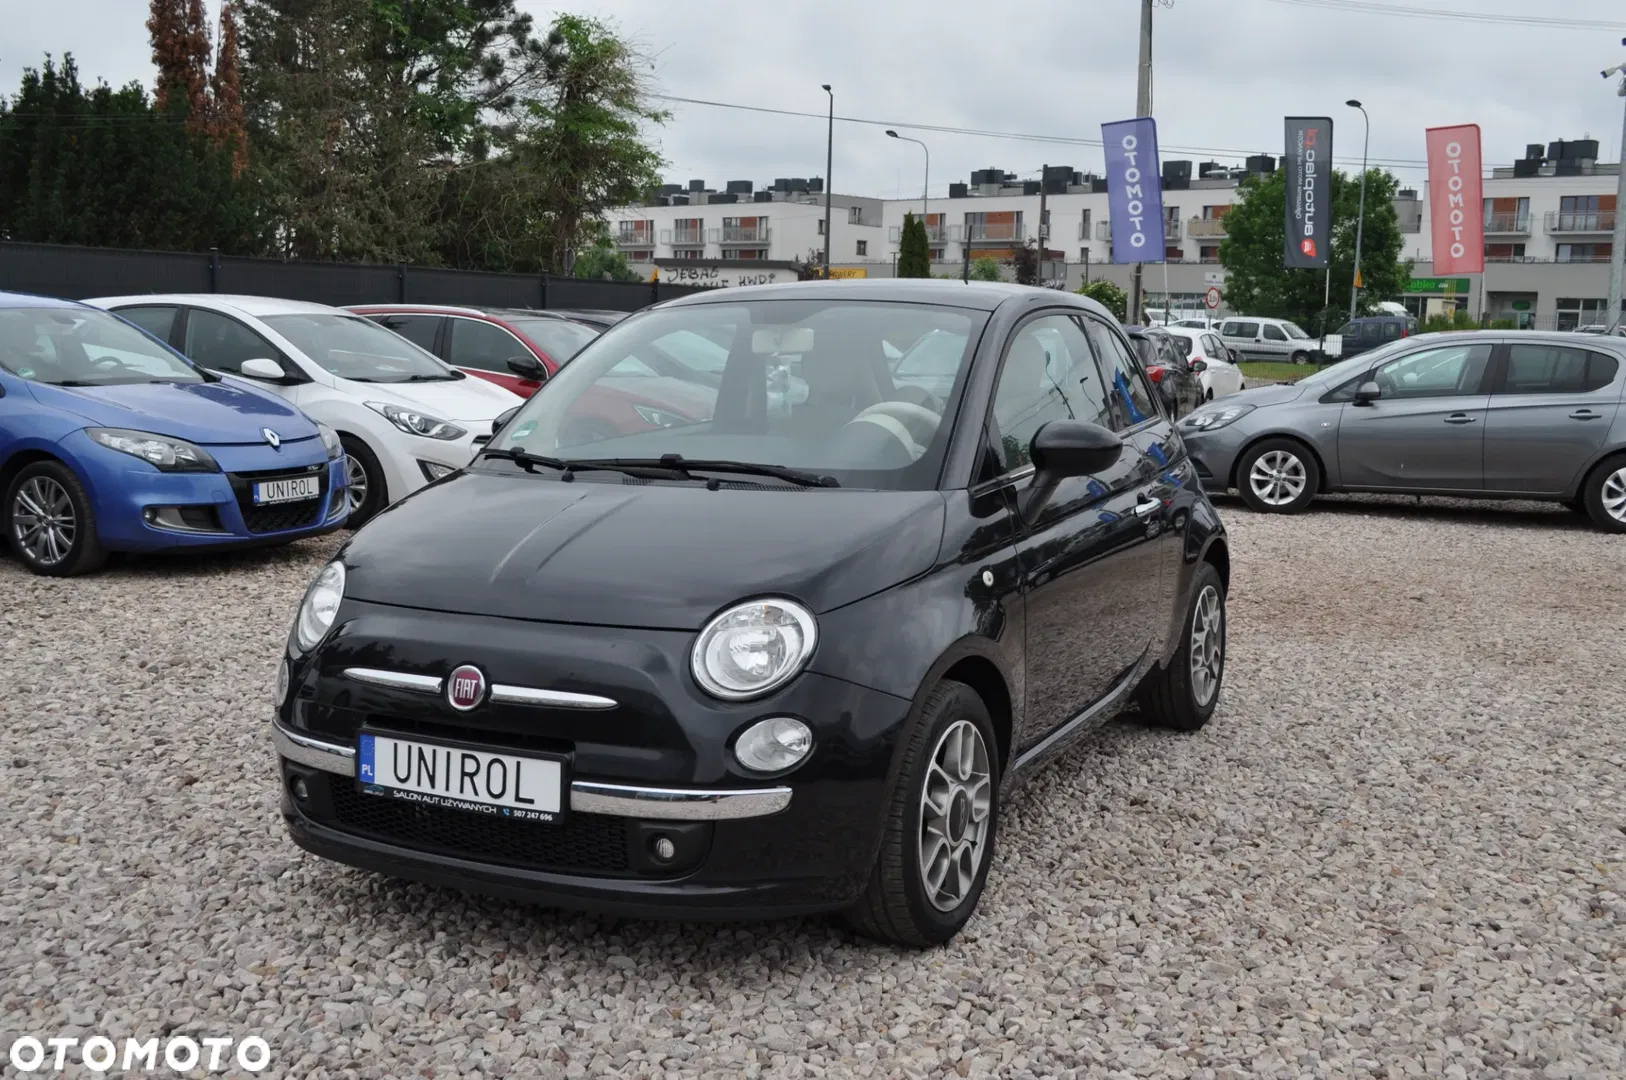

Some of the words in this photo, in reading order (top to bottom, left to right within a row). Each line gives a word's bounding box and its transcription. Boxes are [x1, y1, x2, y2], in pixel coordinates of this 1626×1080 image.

[1122, 135, 1145, 247] OTOMOTO
[1446, 142, 1465, 258] OTOMOTO
[267, 480, 313, 499] UNIROL
[454, 678, 478, 699] FIAT
[361, 764, 373, 776] PL
[394, 743, 535, 804] UNIROL
[393, 790, 421, 801] SALON
[422, 795, 440, 804] AUT
[440, 798, 497, 814] UŻYWANYCH
[526, 812, 539, 820] 247
